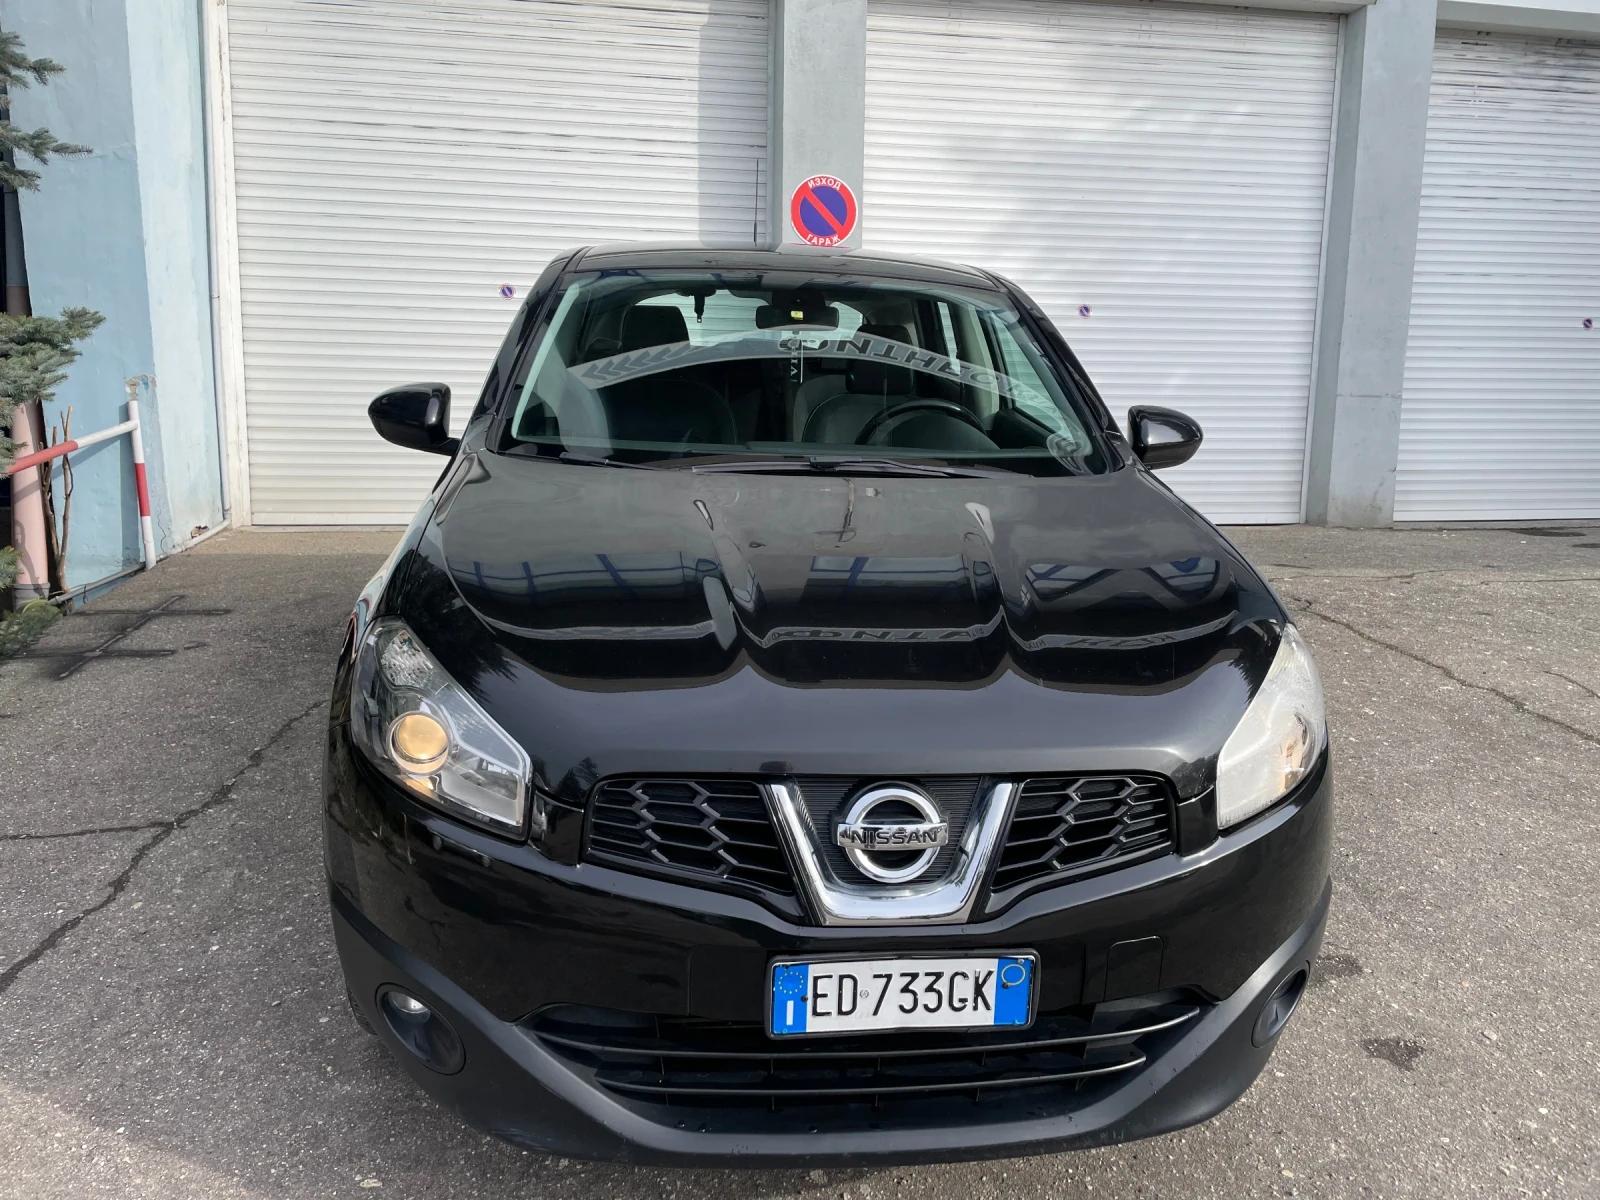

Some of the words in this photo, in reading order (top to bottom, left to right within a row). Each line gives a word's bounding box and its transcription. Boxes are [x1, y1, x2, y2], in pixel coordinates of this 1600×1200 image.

[807, 177, 842, 191] ИЗХОД
[806, 234, 841, 246] ГАРАЖ
[850, 830, 938, 845] NISSAN
[811, 973, 859, 1018] ED
[871, 968, 995, 1017] 733GK
